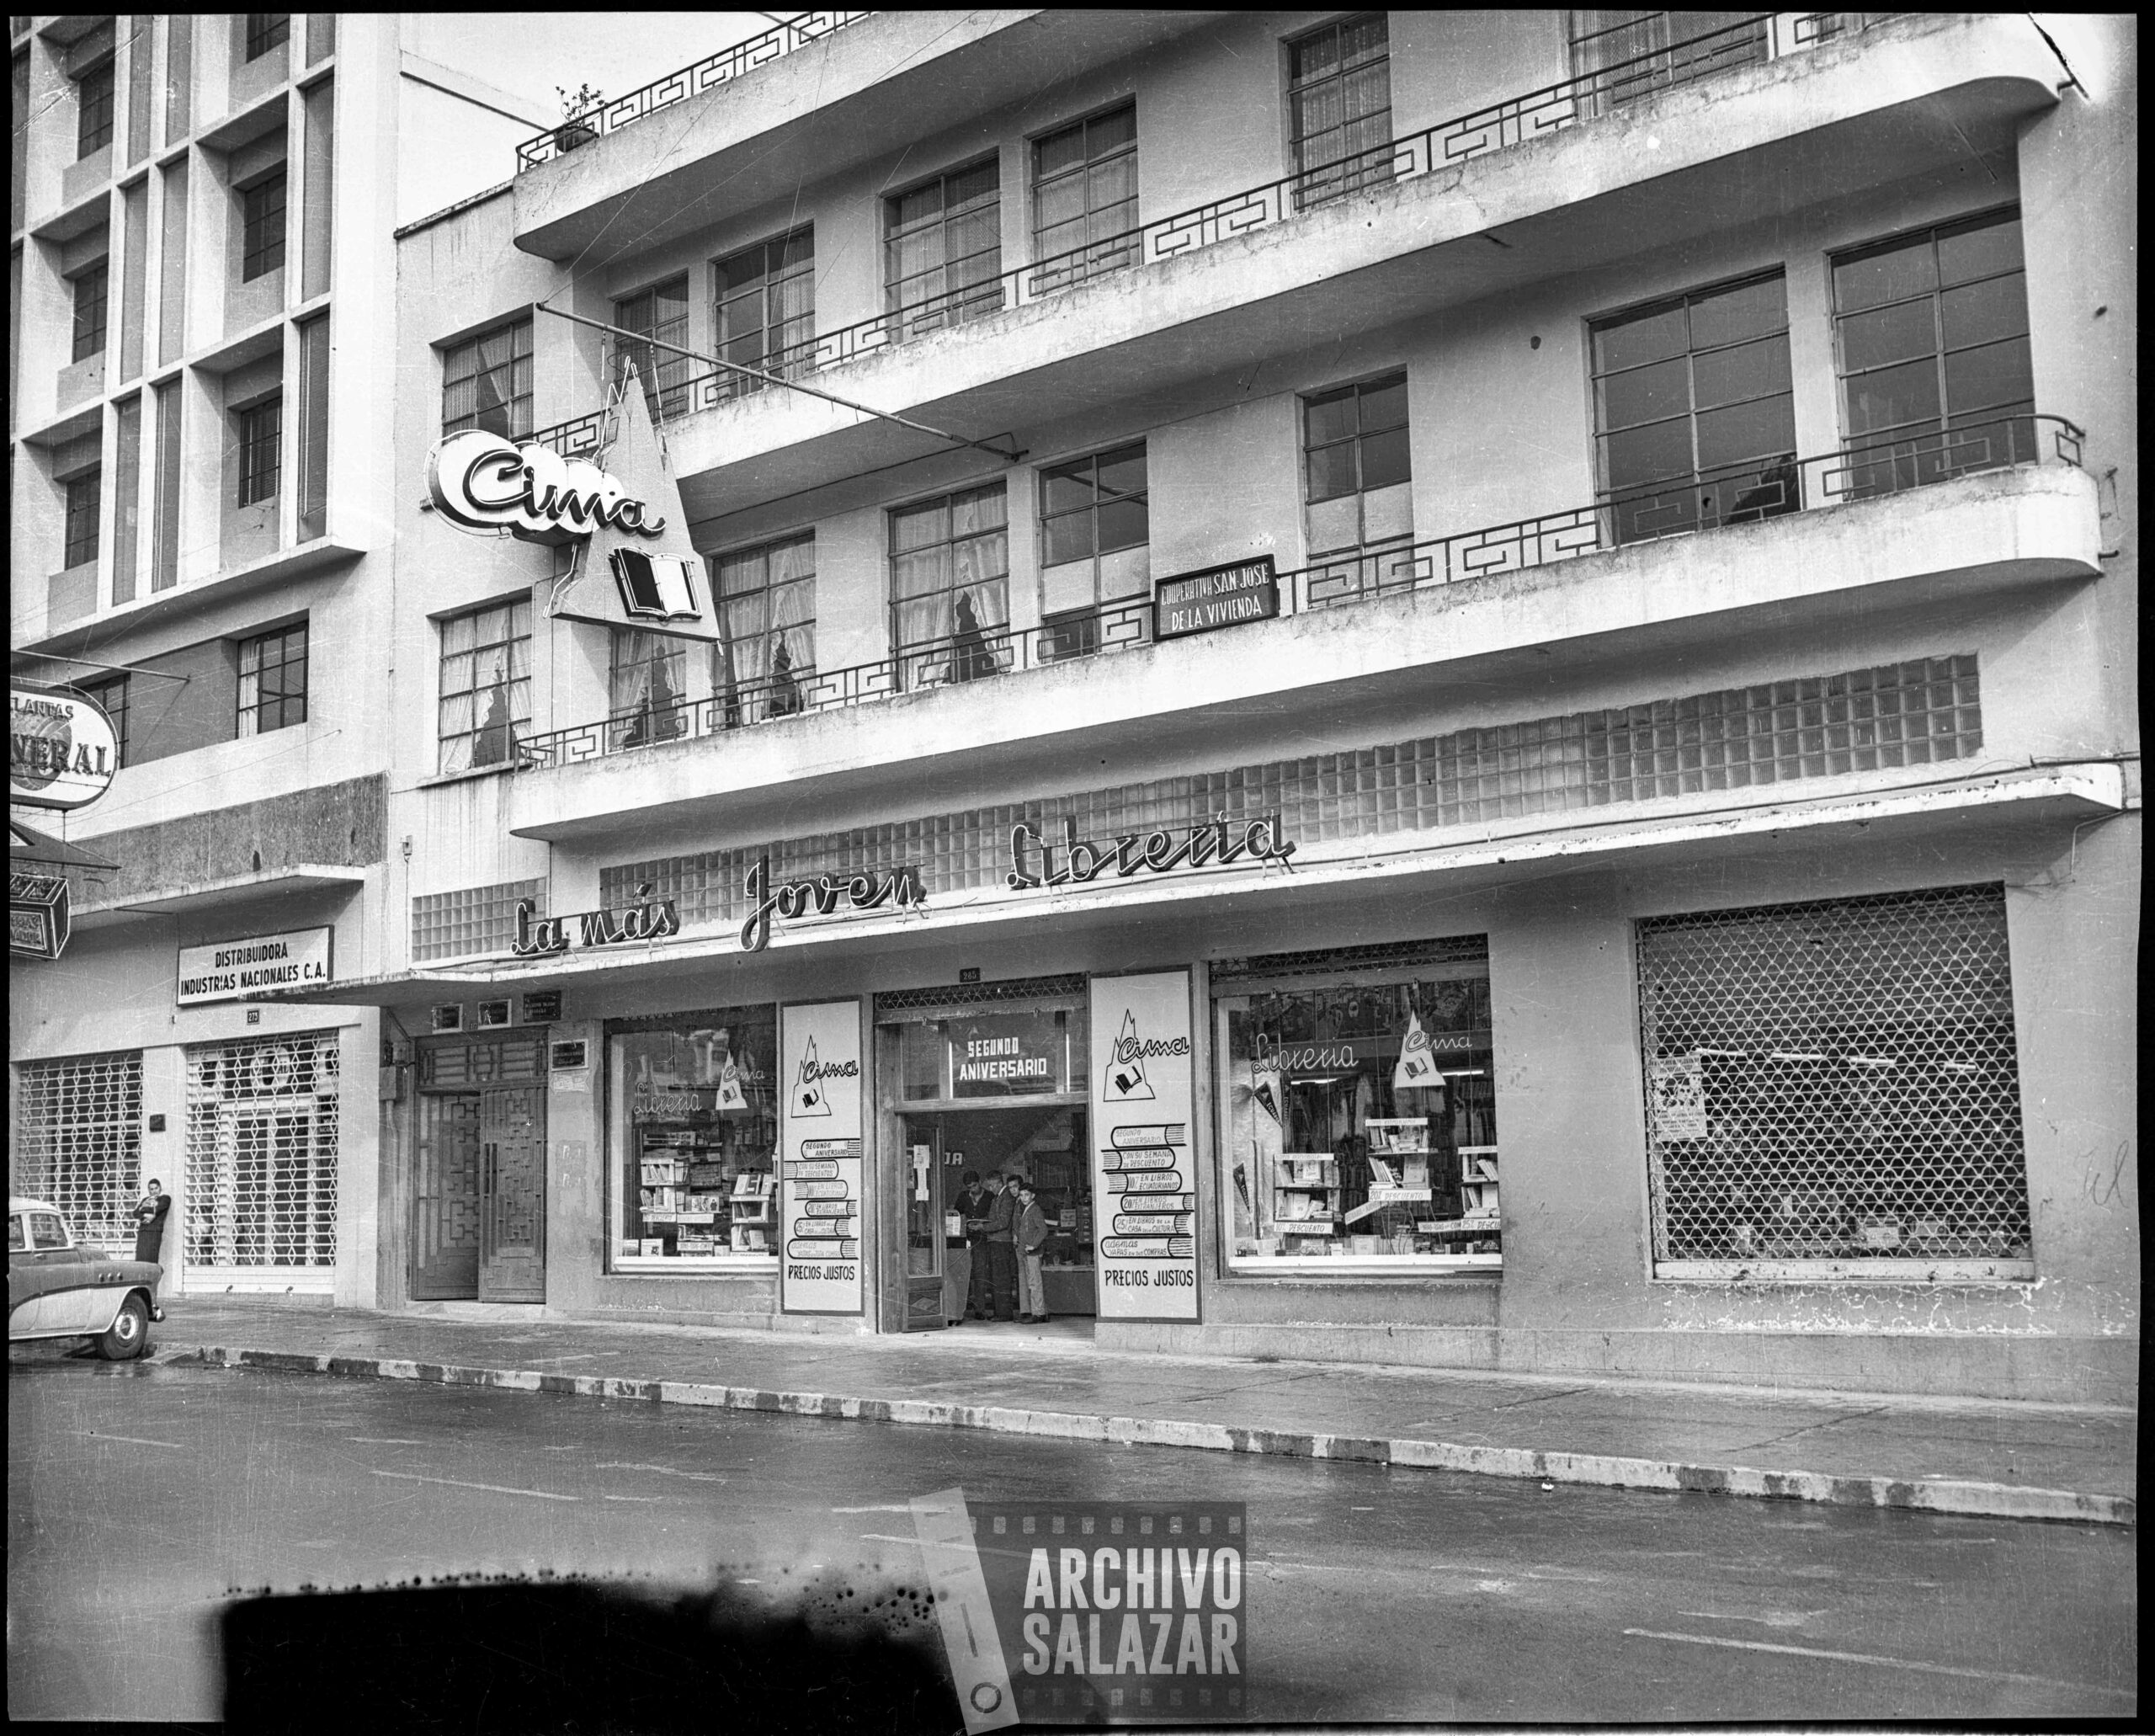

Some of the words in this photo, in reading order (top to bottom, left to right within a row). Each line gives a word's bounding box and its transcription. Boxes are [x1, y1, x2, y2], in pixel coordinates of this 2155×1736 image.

[462, 449, 666, 535] Cima
[1162, 577, 1212, 605] COOPERATIVA
[1214, 571, 1237, 594] SAN
[1172, 610, 1184, 631] DE
[1188, 608, 1202, 628] LA
[1207, 595, 1262, 624] VIVIENDA
[510, 897, 570, 956] La
[216, 942, 288, 968] DISTRIBUIDORA
[181, 973, 236, 996] INDUSTRIAS
[241, 965, 298, 988] NACIONALES
[968, 1037, 1019, 1057] SEGUNDO
[1118, 1036, 1189, 1064] Cima
[1405, 1030, 1472, 1052] Cima
[723, 1064, 765, 1083] Cima
[803, 1060, 858, 1084] Cima
[960, 1058, 1046, 1080] ANIVERSARIO
[1122, 1137, 1162, 1145] ANIVERSARIO
[1130, 1158, 1166, 1167] DESCUENTO
[1139, 1181, 1179, 1190] ECUATORIANOS
[1152, 1224, 1174, 1233] CULTURA
[1289, 1223, 1325, 1232] DESCUENTO
[788, 1265, 821, 1280] PRECIOS
[823, 1265, 854, 1281] JUSTOS
[1104, 1270, 1148, 1286] PRECIOS
[1154, 1270, 1194, 1286] JUSTOS
